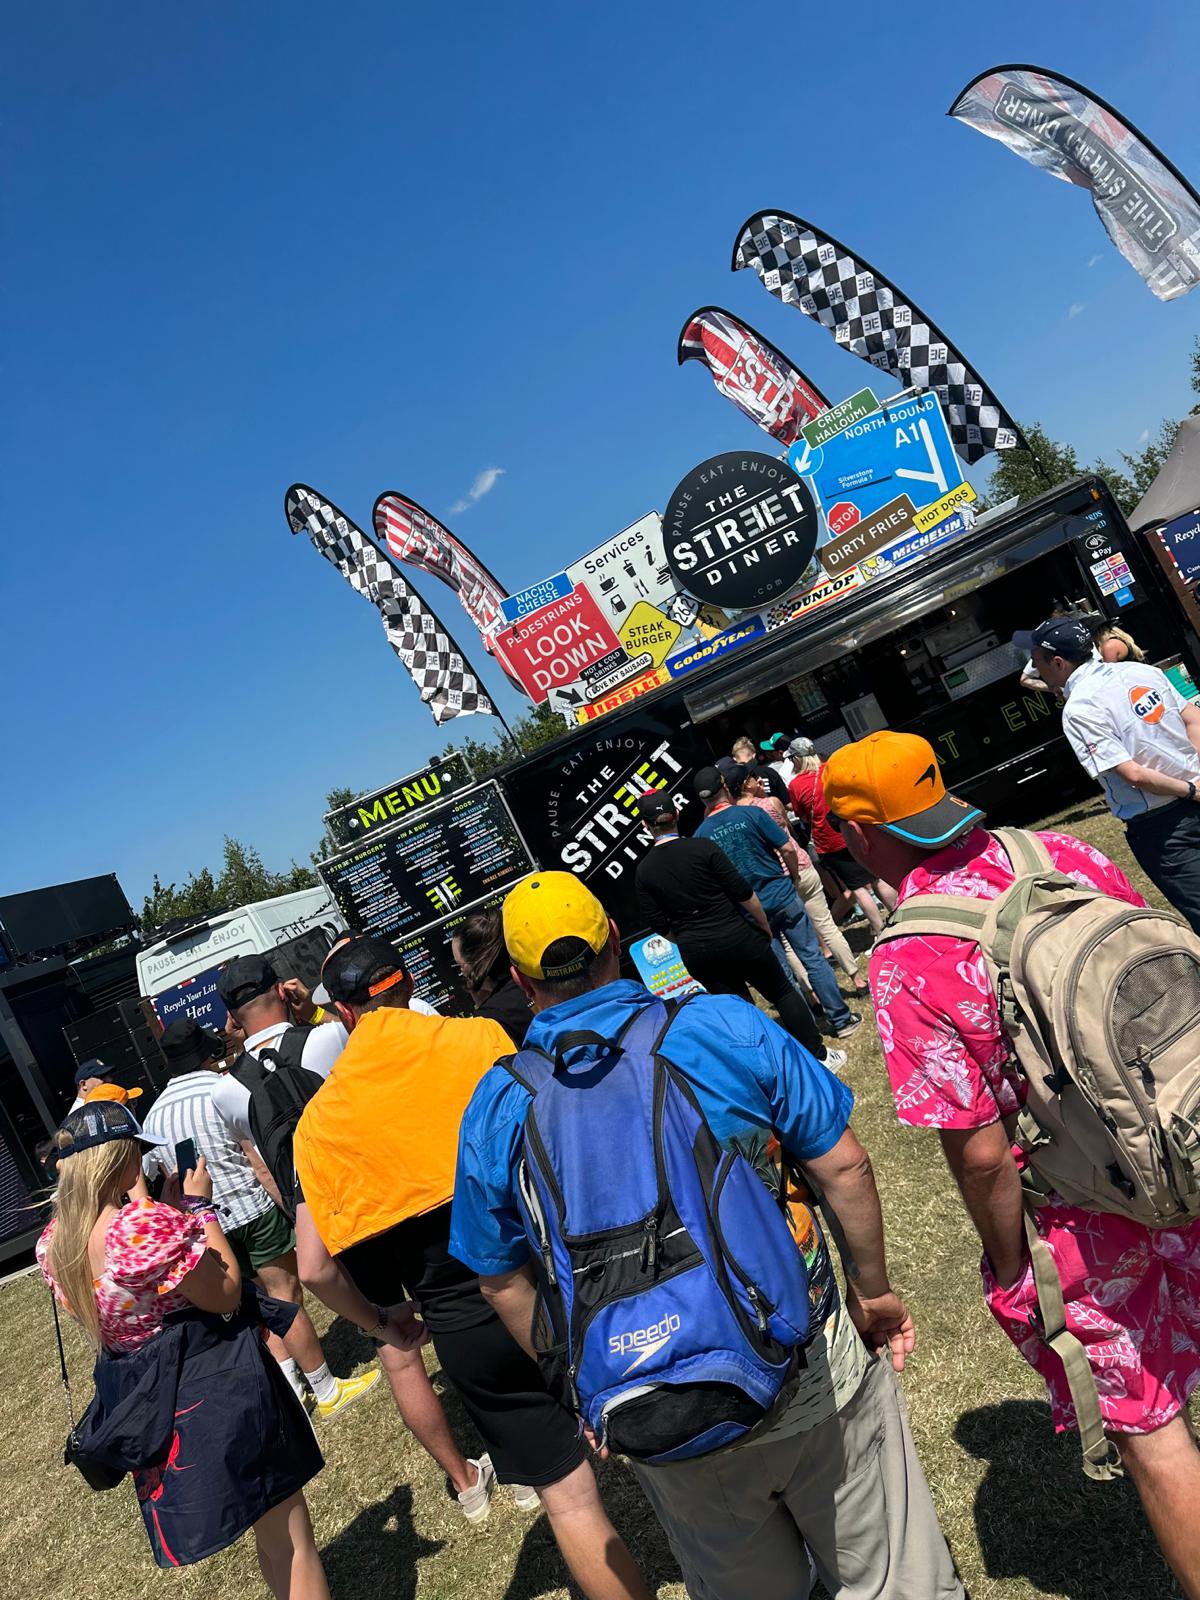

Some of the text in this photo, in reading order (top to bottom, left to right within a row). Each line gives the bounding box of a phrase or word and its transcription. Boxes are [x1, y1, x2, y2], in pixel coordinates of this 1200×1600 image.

[1003, 94, 1062, 139] DINER
[1121, 190, 1164, 238] THE
[815, 406, 868, 444] HALLOUMI
[817, 400, 855, 429] CRISPY
[844, 400, 934, 441] NORTH BOUND
[894, 425, 920, 449] A1
[838, 468, 874, 484] Silverstone
[841, 476, 867, 489] Formula
[672, 461, 788, 537] PAUSE EAT ENJOY
[705, 484, 748, 513] THE
[919, 490, 969, 526] HOT DOGS
[672, 483, 807, 572] STREET
[828, 508, 909, 566] DIRTY FRIES
[832, 506, 856, 532] STOP
[584, 531, 645, 574] Services
[706, 530, 800, 586] DINER
[1097, 544, 1113, 557] Pay
[515, 581, 556, 605] NACHO
[517, 589, 561, 615] CHEESE
[789, 573, 855, 614] DUNLOP
[505, 593, 584, 648] PEDESTRIANS
[628, 621, 665, 638] STEAK
[673, 598, 696, 628] 262
[523, 612, 591, 667] LOOK
[625, 631, 673, 650] BURGER
[673, 625, 757, 670] GOODYEAR
[532, 632, 609, 692] DOWN
[583, 665, 599, 677] HOT
[603, 651, 621, 666] COLD
[593, 661, 618, 678] DRINKS
[608, 671, 620, 685] MY
[619, 656, 650, 680] SAUSAGE
[1133, 690, 1161, 717] Gulf
[356, 771, 442, 829] MENU
[550, 738, 645, 838] PAUSE EAT ENJOY
[575, 764, 615, 804] THE
[560, 740, 683, 874] STREET
[604, 791, 691, 879] DINR
[709, 820, 747, 840] ALTROCK
[329, 857, 354, 873] STREET
[353, 842, 384, 861] BURGERS
[146, 954, 176, 975] PAUSE
[212, 922, 246, 946] ENJOY
[545, 961, 584, 977] AUSTRALIA
[162, 981, 217, 1014] Recycle Your Litt
[184, 1001, 213, 1020] Here
[607, 1312, 681, 1356] speedo
